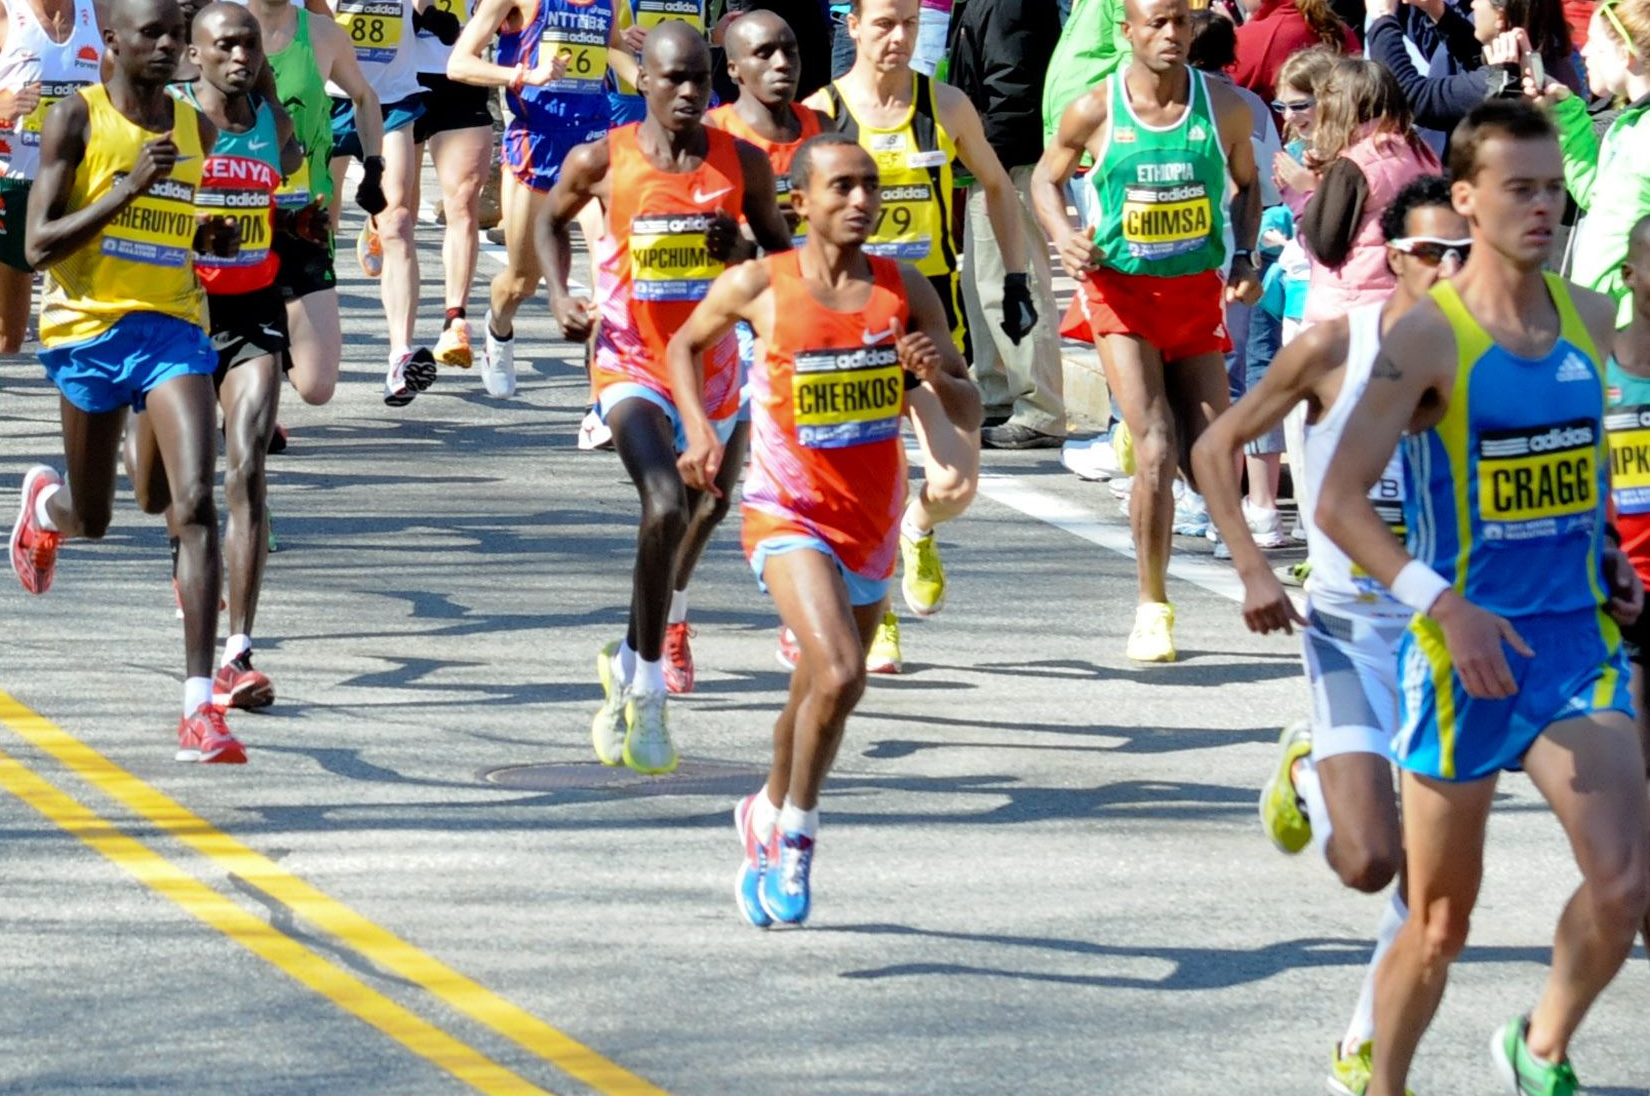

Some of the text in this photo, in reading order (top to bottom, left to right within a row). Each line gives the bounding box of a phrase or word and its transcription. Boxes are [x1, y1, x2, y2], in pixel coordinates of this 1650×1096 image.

[364, 5, 402, 16] adidas
[664, 1, 699, 13] adidas
[351, 16, 385, 43] 88
[569, 32, 606, 46] adidas
[202, 156, 273, 188] KENYA
[1136, 162, 1195, 183] ETHIOPIA
[149, 182, 192, 202] adidas
[225, 192, 270, 206] adidas
[880, 187, 930, 201] adidas
[1157, 185, 1206, 202] adidas
[873, 205, 912, 237] 79
[1126, 206, 1208, 237] CHIMSA
[632, 246, 715, 269] KIPCHUM
[835, 349, 898, 370] adidas
[797, 376, 899, 415] CHERKOS
[1529, 426, 1594, 452] adidas
[1492, 457, 1591, 513] CRAGG
